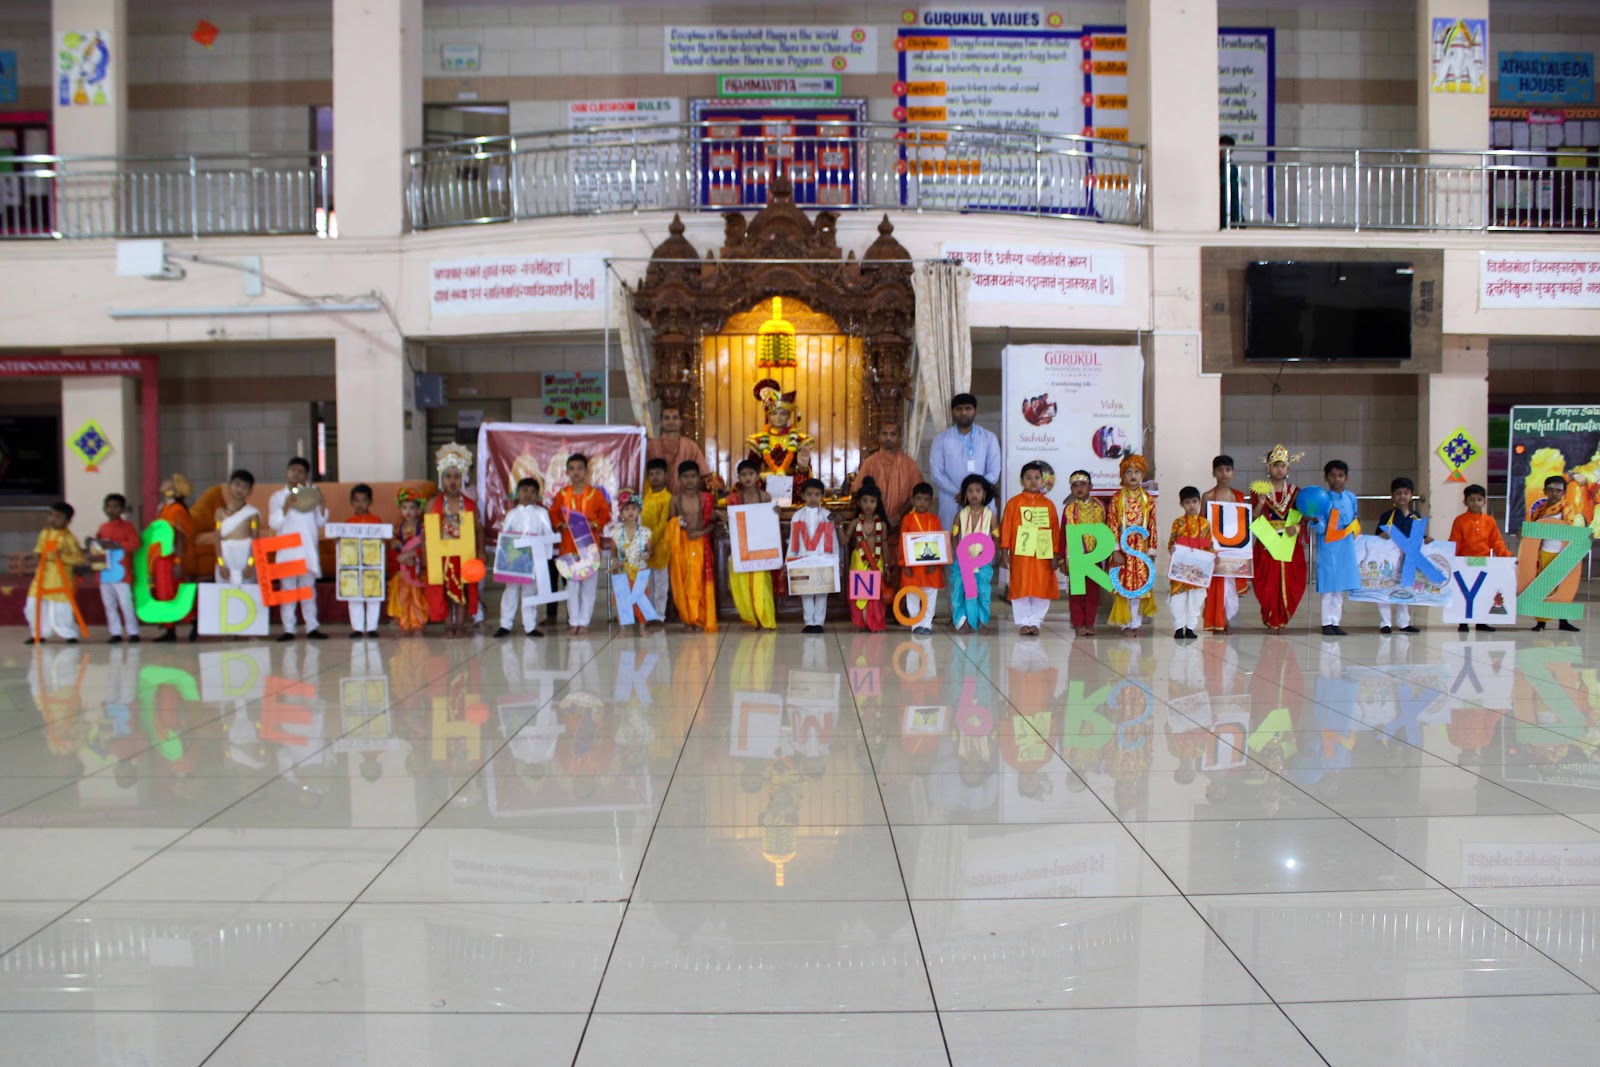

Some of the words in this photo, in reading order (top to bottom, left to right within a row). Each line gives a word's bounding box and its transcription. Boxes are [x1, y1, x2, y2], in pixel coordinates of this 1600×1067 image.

[924, 11, 987, 27] GURUKUL
[991, 12, 1040, 27] VALUES
[637, 101, 671, 111] RULES
[1519, 78, 1566, 93] HOUSE
[89, 359, 142, 371] SCHOOL
[1044, 352, 1102, 367] GURUKUL
[1101, 400, 1123, 412] Vidya
[1514, 419, 1554, 437] Gurukul
[1019, 433, 1055, 444] Sadvidya
[735, 511, 779, 562] L
[791, 521, 834, 553] M
[1023, 509, 1034, 522] Q
[1210, 503, 1250, 549] U
[1249, 508, 1303, 562] V
[423, 511, 477, 585] H
[555, 506, 601, 582] J
[956, 532, 996, 600] P
[1065, 522, 1117, 595] R
[1109, 525, 1156, 598] S
[1380, 517, 1448, 587] X
[34, 540, 90, 646] A
[133, 519, 198, 623] C
[252, 532, 313, 607] E
[513, 533, 569, 607] I
[854, 573, 875, 596] N
[1516, 521, 1593, 620] Z
[219, 587, 256, 633] D
[612, 569, 659, 625] K
[893, 585, 928, 626] O
[1453, 570, 1488, 619] Y
